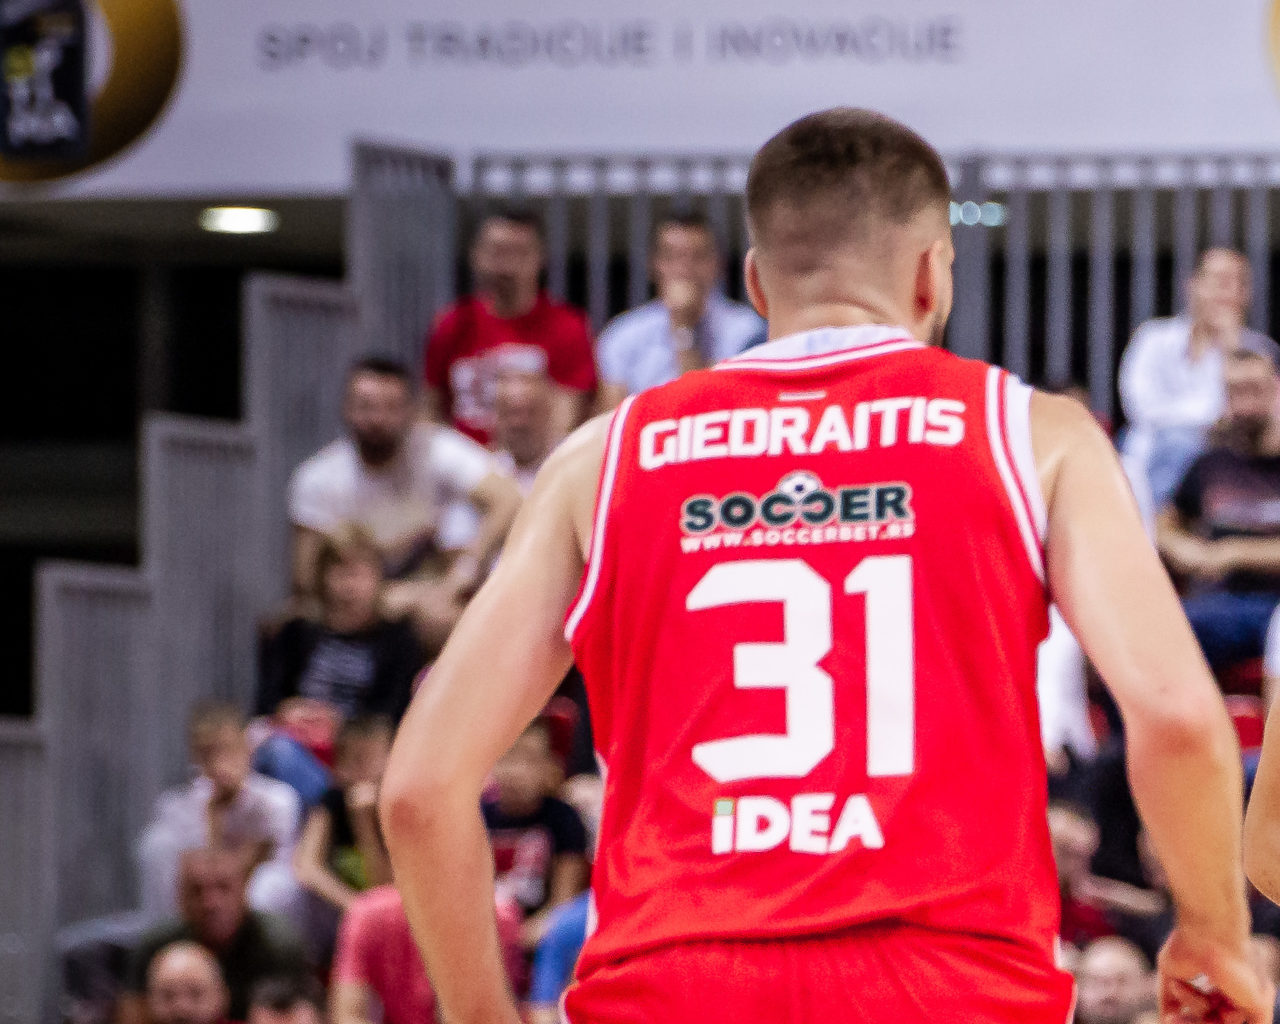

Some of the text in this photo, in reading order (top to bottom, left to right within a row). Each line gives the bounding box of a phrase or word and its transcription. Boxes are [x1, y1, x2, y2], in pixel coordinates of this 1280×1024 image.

[639, 396, 967, 471] GIEDRAITIS
[681, 480, 913, 534] SOCCER
[685, 553, 916, 785] 31
